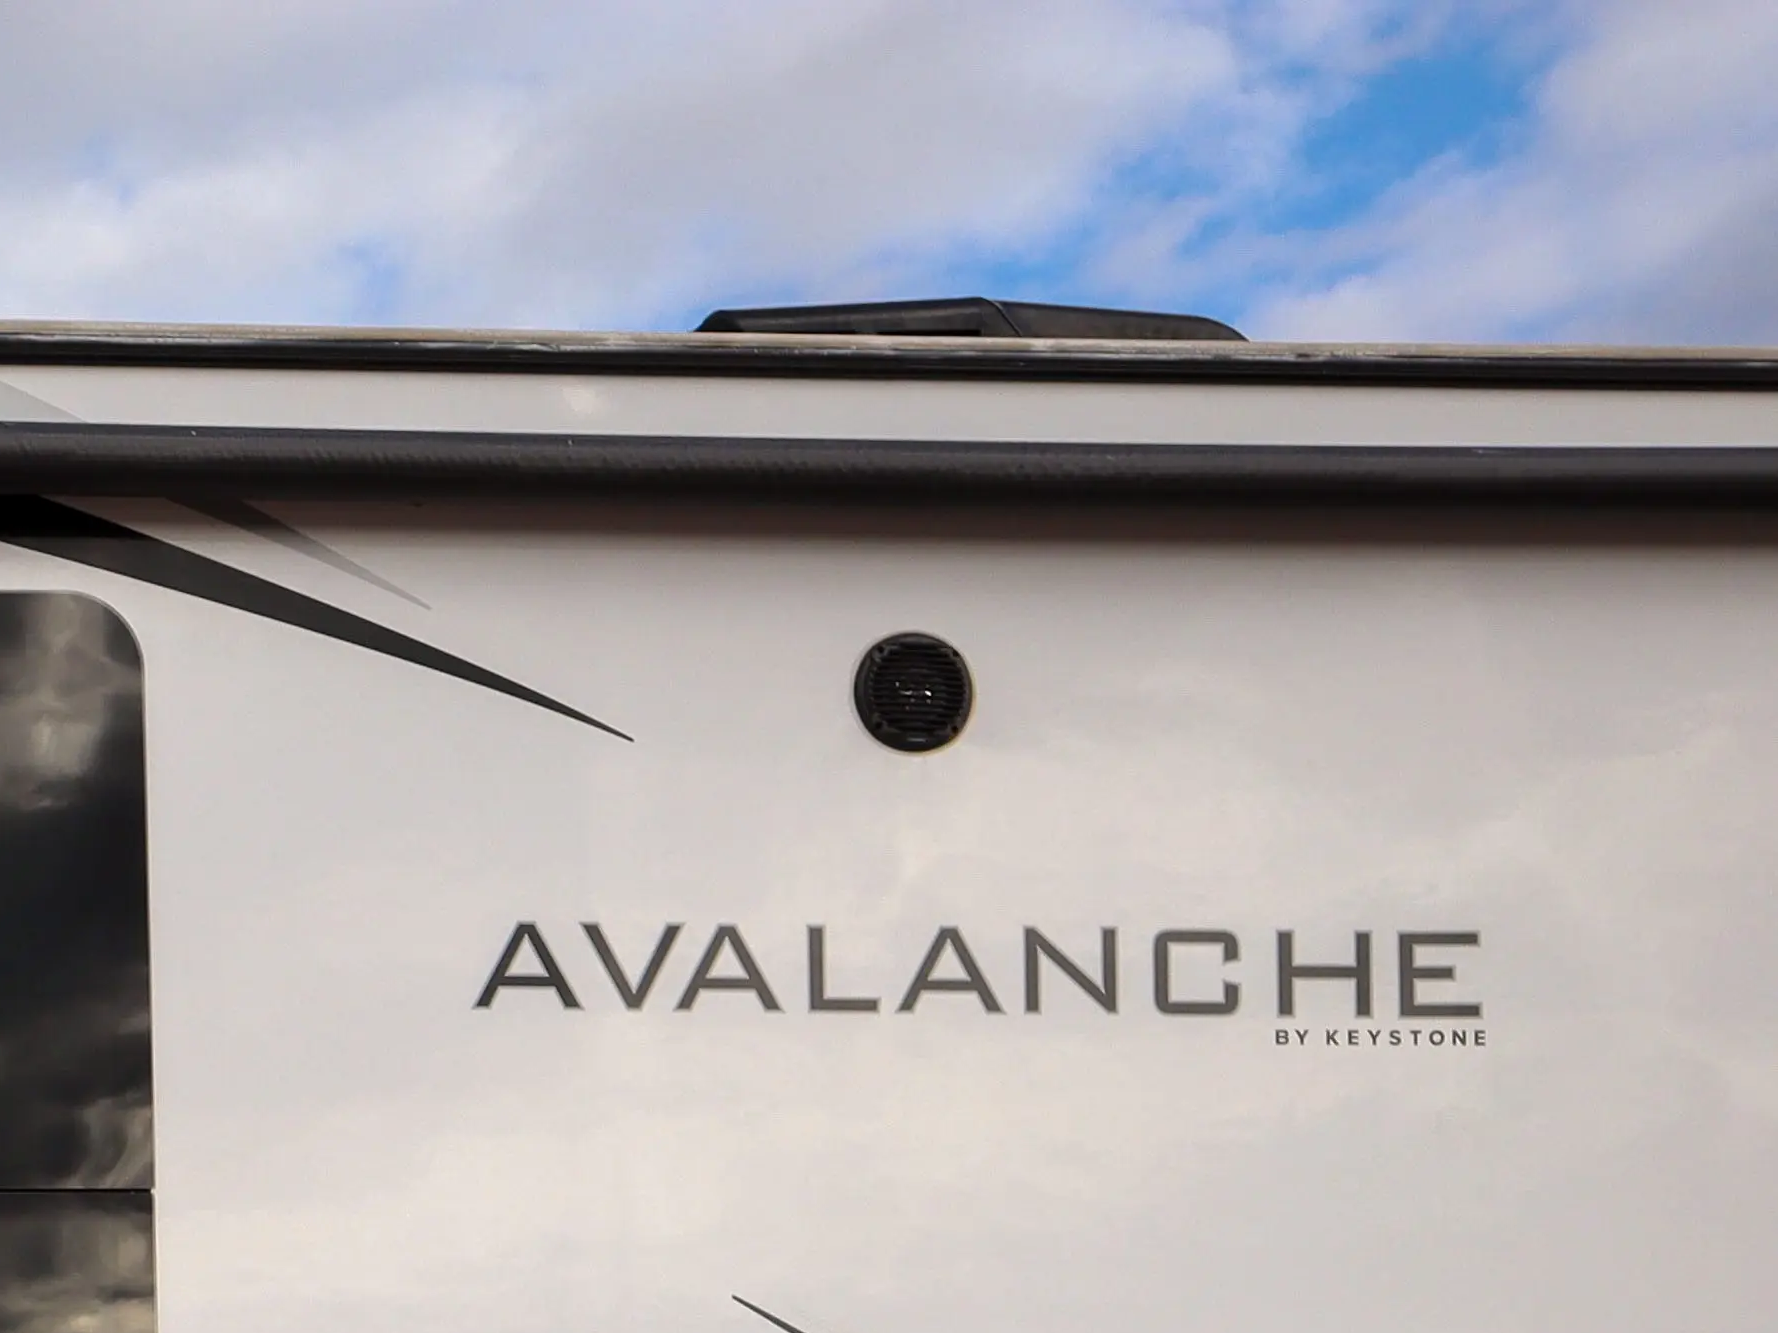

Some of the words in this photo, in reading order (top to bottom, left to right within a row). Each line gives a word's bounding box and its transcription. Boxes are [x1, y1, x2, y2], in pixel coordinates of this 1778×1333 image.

[471, 920, 1483, 1019] AVALANCHE
[1274, 1029, 1309, 1046] BY
[1325, 1029, 1487, 1046] KEYSTONE
